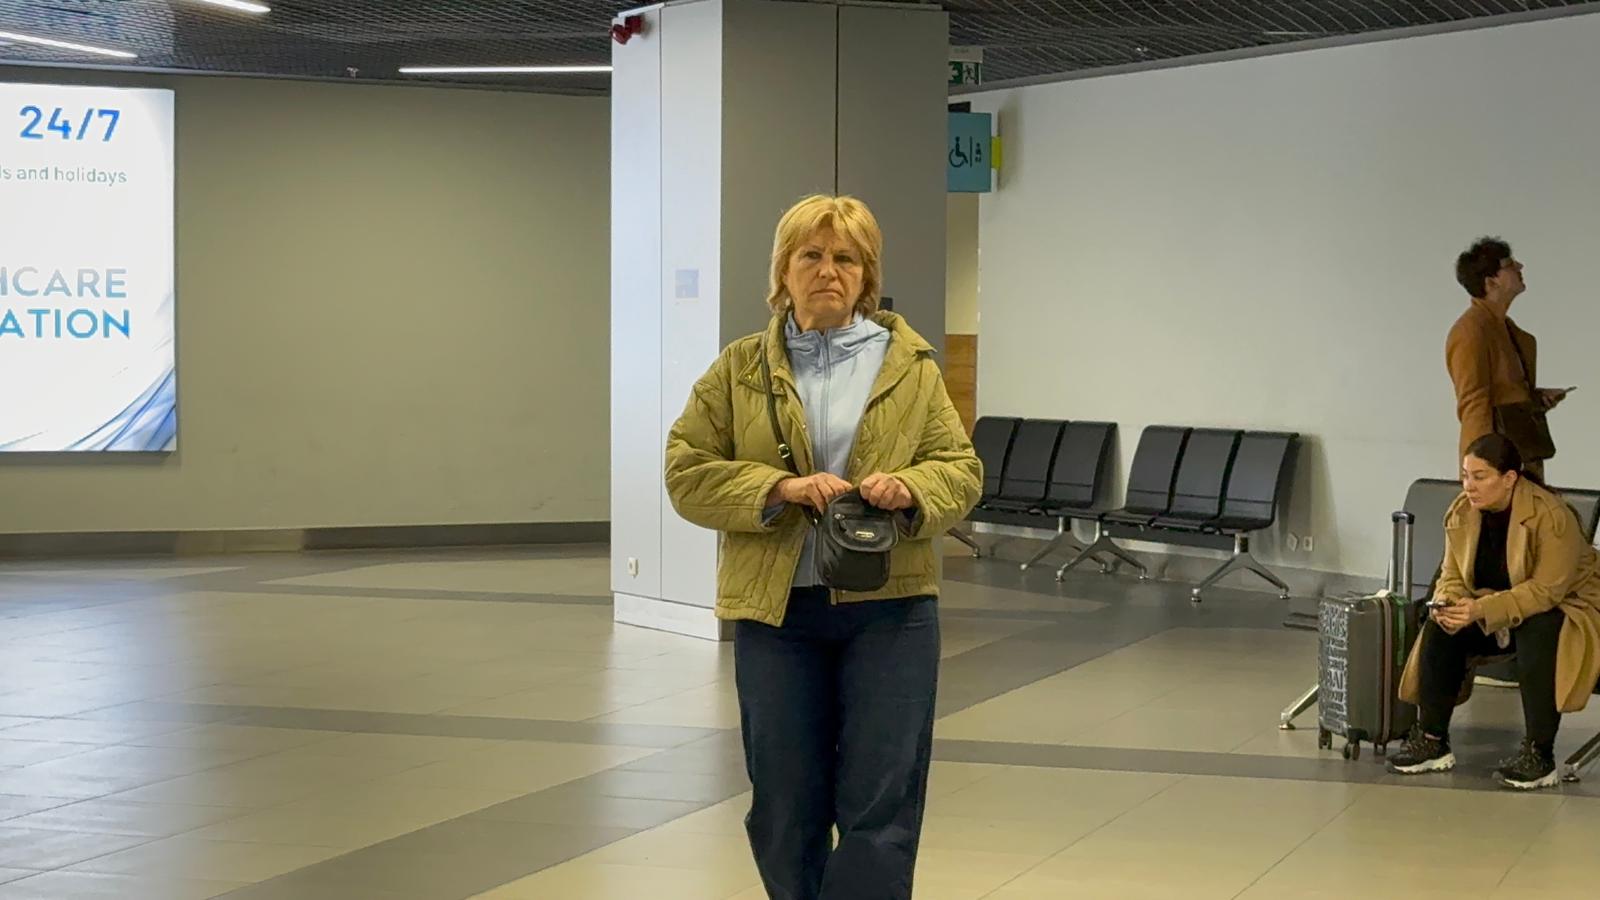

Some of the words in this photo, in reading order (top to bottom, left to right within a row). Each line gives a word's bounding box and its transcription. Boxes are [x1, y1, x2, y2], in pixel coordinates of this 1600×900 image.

[19, 105, 120, 142] 24/7
[0, 165, 11, 180] s
[16, 166, 48, 180] and
[54, 166, 127, 187] holidays
[0, 308, 130, 339] ATION
